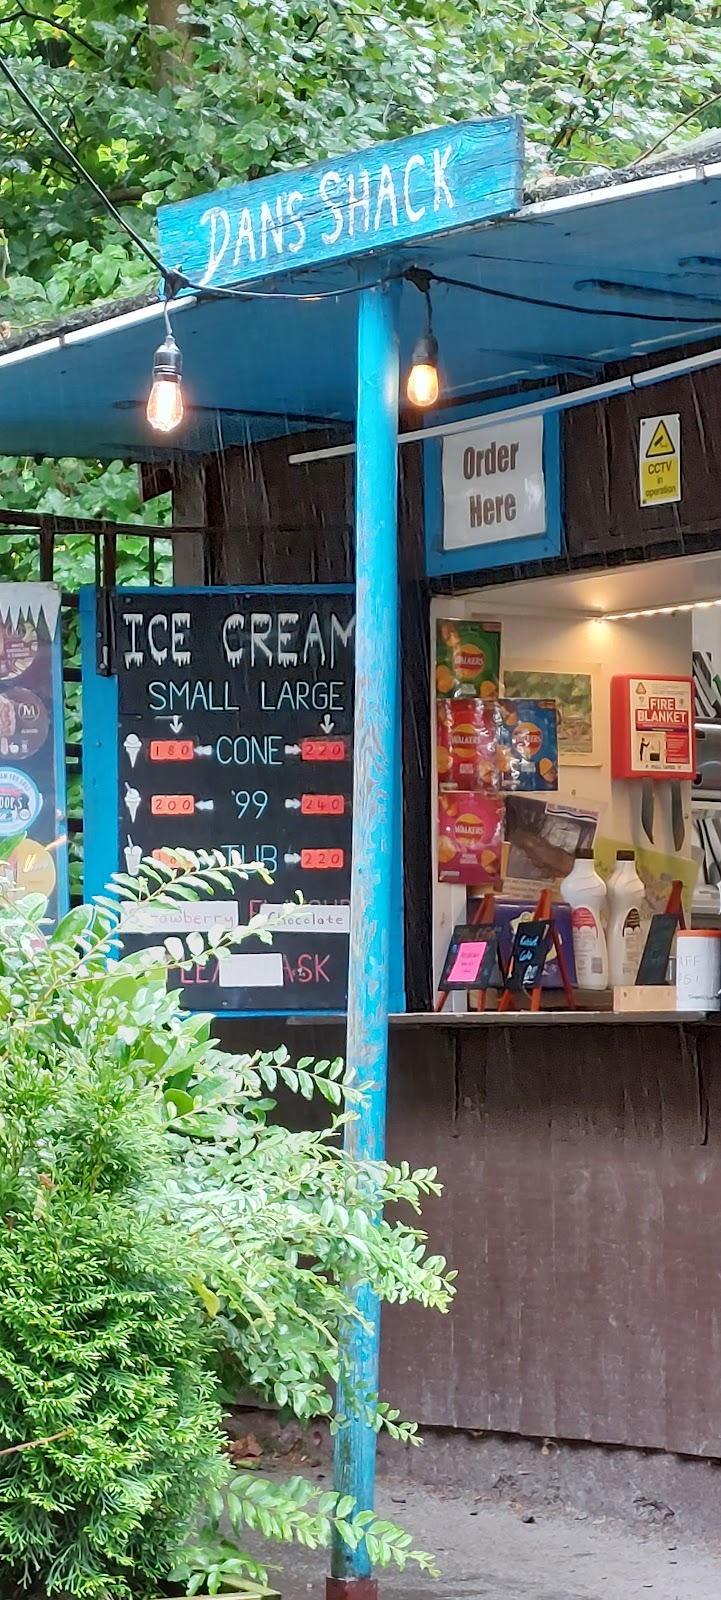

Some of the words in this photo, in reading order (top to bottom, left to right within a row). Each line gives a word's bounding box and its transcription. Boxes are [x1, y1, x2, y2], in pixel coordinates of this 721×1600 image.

[319, 146, 454, 245] SHACK
[463, 441, 519, 480] Order
[648, 461, 672, 475] CCTV
[657, 475, 664, 484] in
[645, 485, 677, 498] operation
[469, 493, 517, 528] Here
[122, 612, 191, 669] ICE
[222, 612, 356, 669] CREAM
[454, 655, 484, 665] WALKERS
[148, 681, 240, 711] SMALL
[261, 681, 345, 711] LARGE
[650, 698, 674, 710] FIRE
[637, 710, 687, 723] BLANKET
[156, 744, 190, 756] 180
[216, 736, 283, 765] CONE
[304, 743, 342, 755] 220
[154, 798, 191, 811] 200
[305, 798, 340, 811] 240
[454, 824, 485, 834] WALKERS
[220, 844, 278, 874] TUB
[304, 852, 341, 865] 220
[128, 908, 235, 930] Sawberry
[282, 953, 331, 983] ASK
